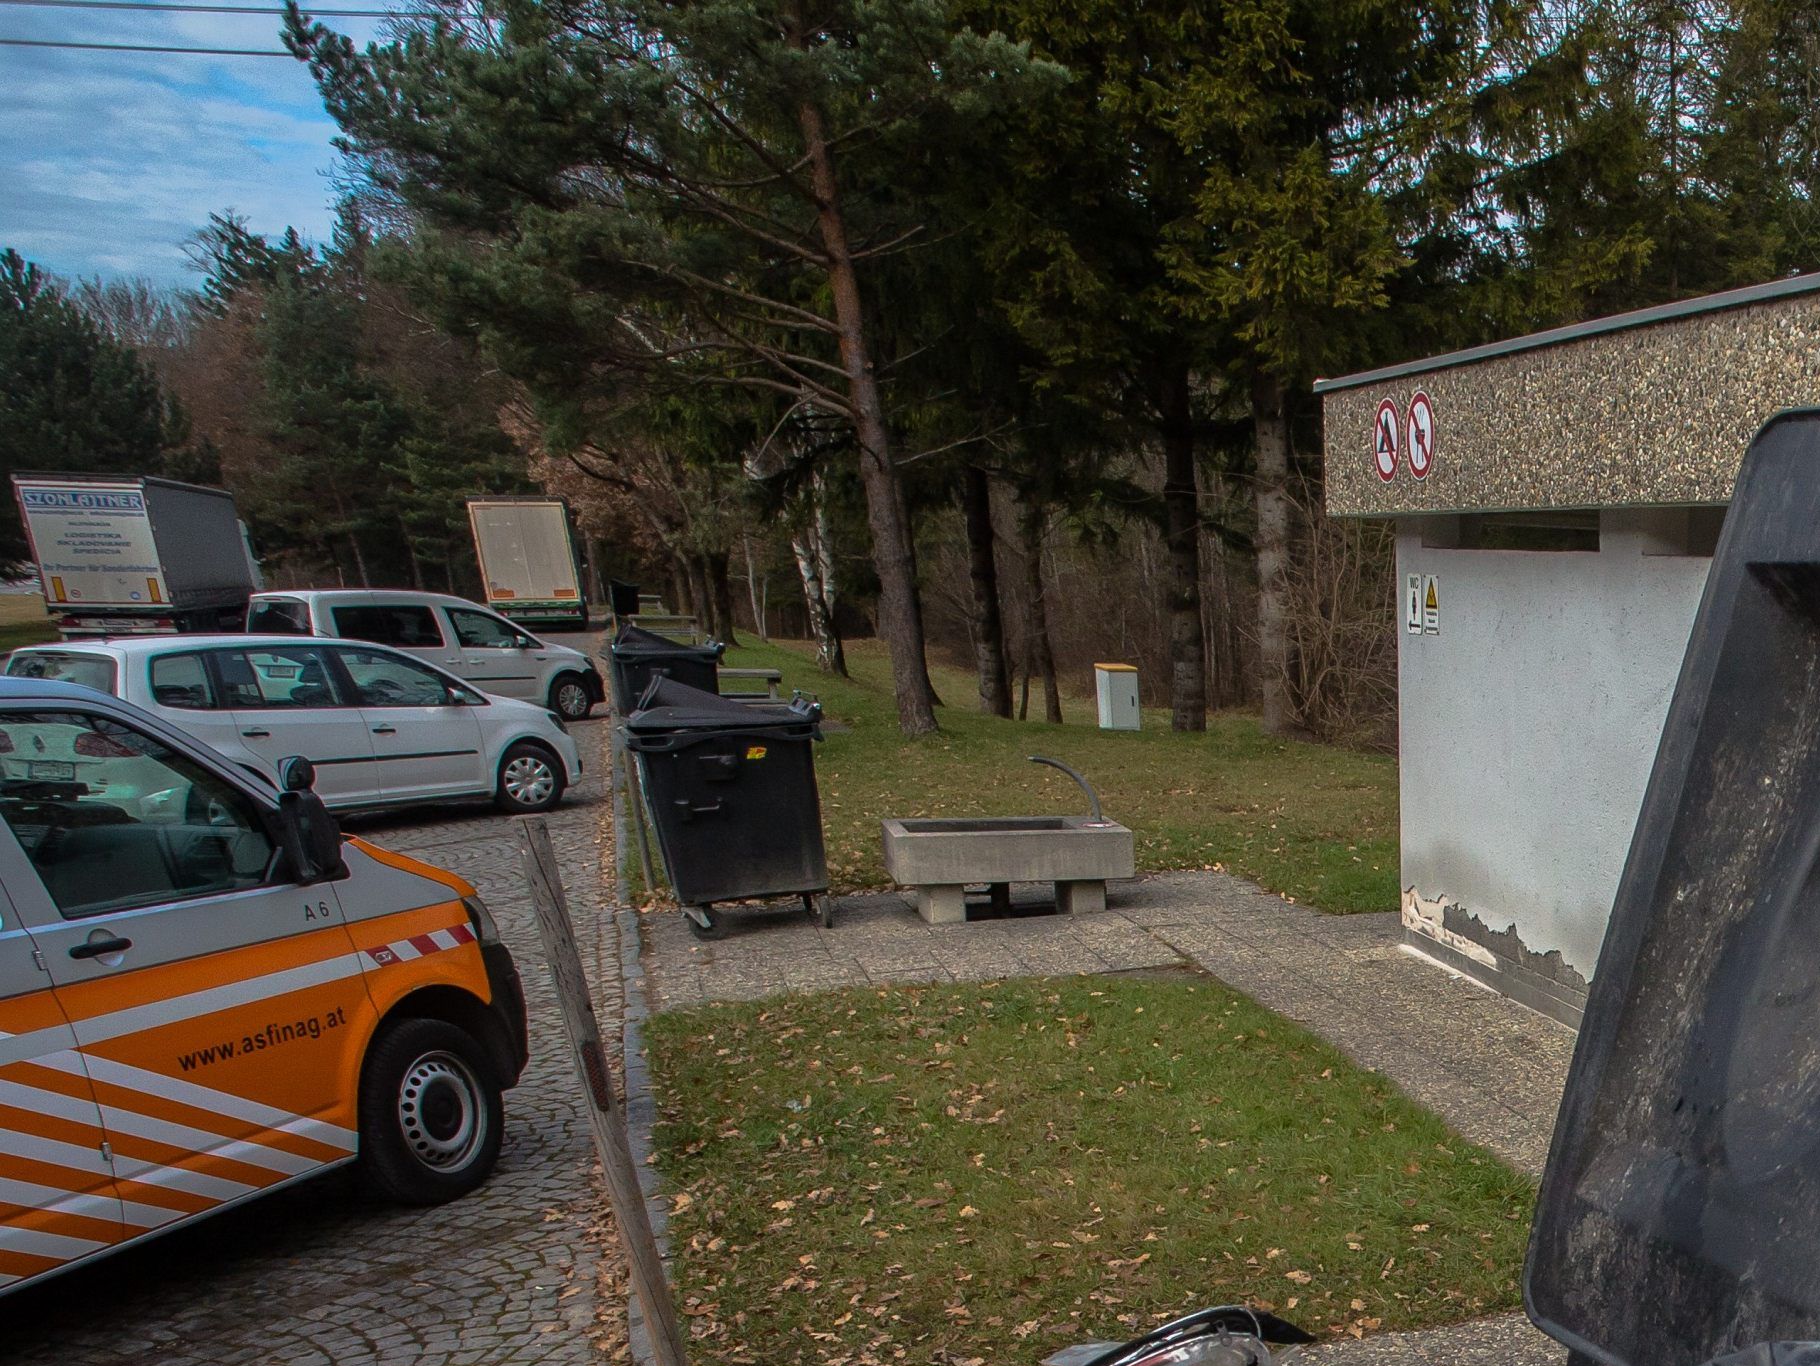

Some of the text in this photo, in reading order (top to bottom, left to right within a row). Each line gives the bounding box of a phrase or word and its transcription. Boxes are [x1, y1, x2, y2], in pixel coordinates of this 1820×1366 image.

[1409, 576, 1419, 590] WC
[304, 901, 330, 922] A 6
[177, 1006, 347, 1072] www.asfinag.at
